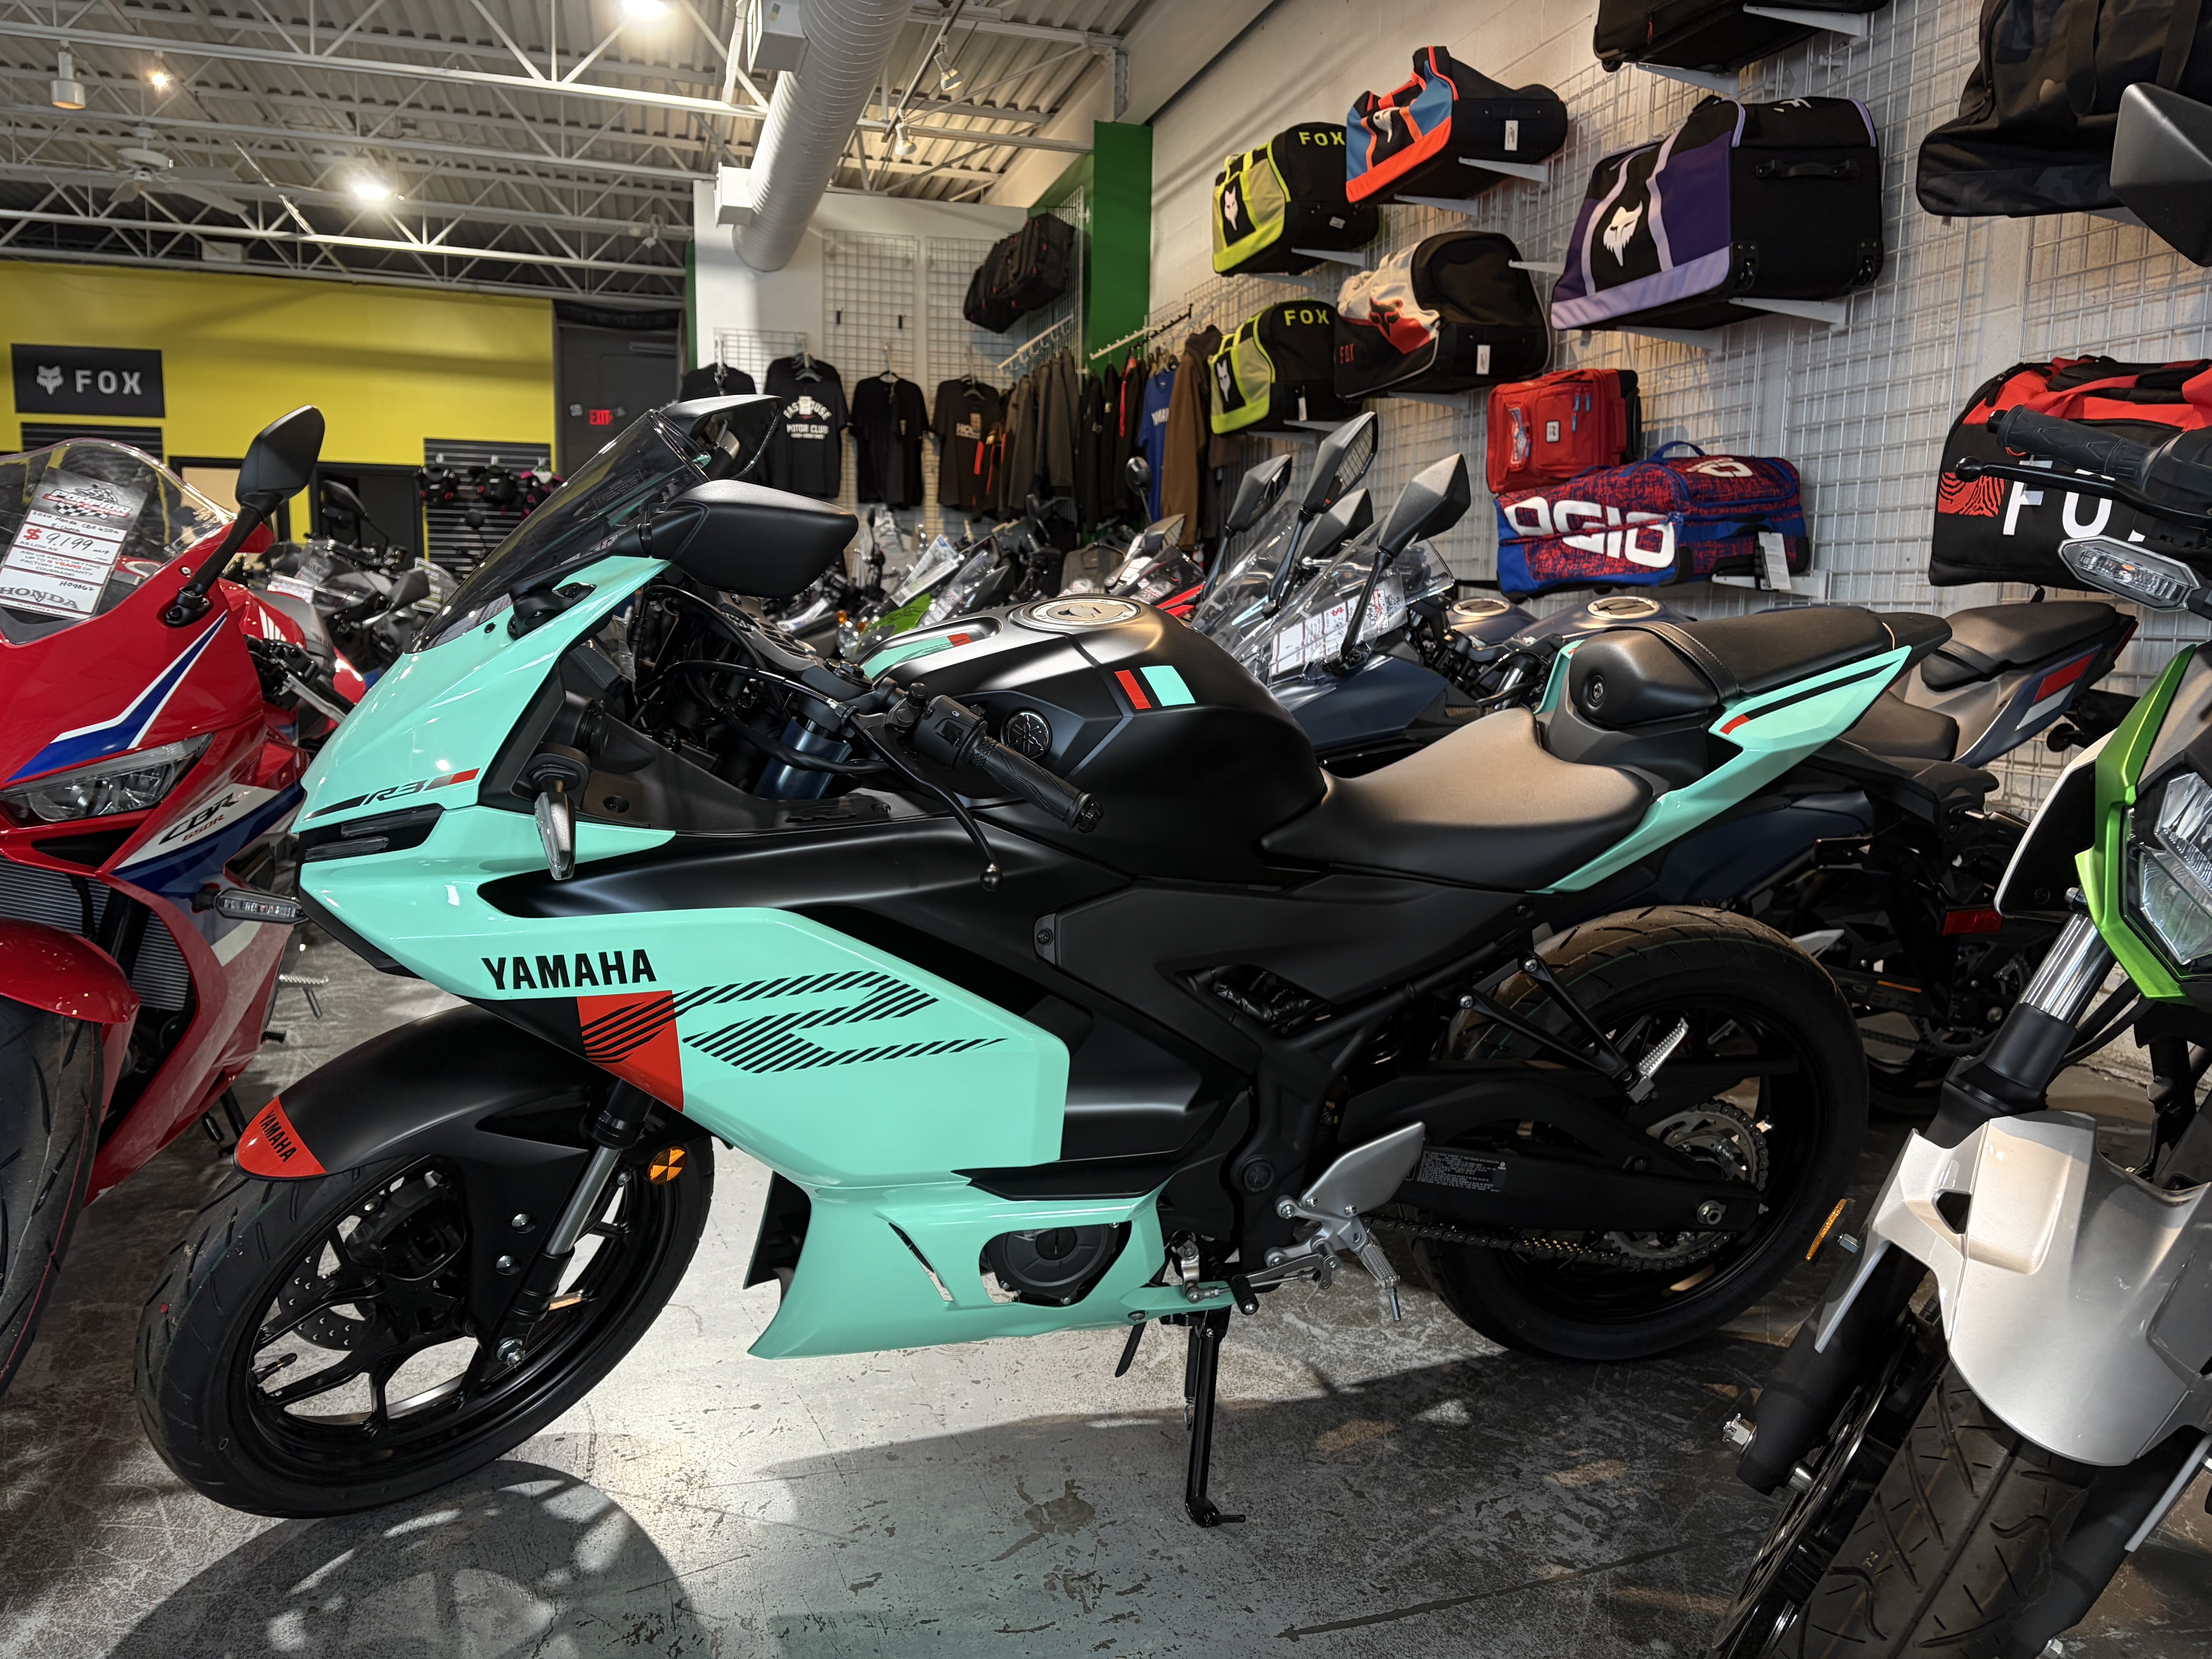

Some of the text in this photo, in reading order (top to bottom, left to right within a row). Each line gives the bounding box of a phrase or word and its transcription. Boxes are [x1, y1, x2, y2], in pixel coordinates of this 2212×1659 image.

[1298, 131, 1346, 147] FOX
[1284, 309, 1330, 326] FOX
[1340, 343, 1355, 364] FOX
[75, 369, 143, 395] FOX
[589, 409, 611, 425] EXIT
[787, 423, 830, 434] MOTOR CLUB
[50, 489, 132, 514] POMPTON
[23, 527, 43, 541] $
[1503, 496, 1675, 568] OGIO
[20, 559, 93, 576] FACTORY WARRANTY
[54, 561, 82, 570] YEARS
[71, 560, 101, 569] GETTING
[0, 587, 80, 611] HONDA
[363, 779, 428, 806] R3
[158, 792, 239, 845] CBR
[481, 948, 657, 991] YAMAHA
[259, 1110, 297, 1163] YAMAHA
